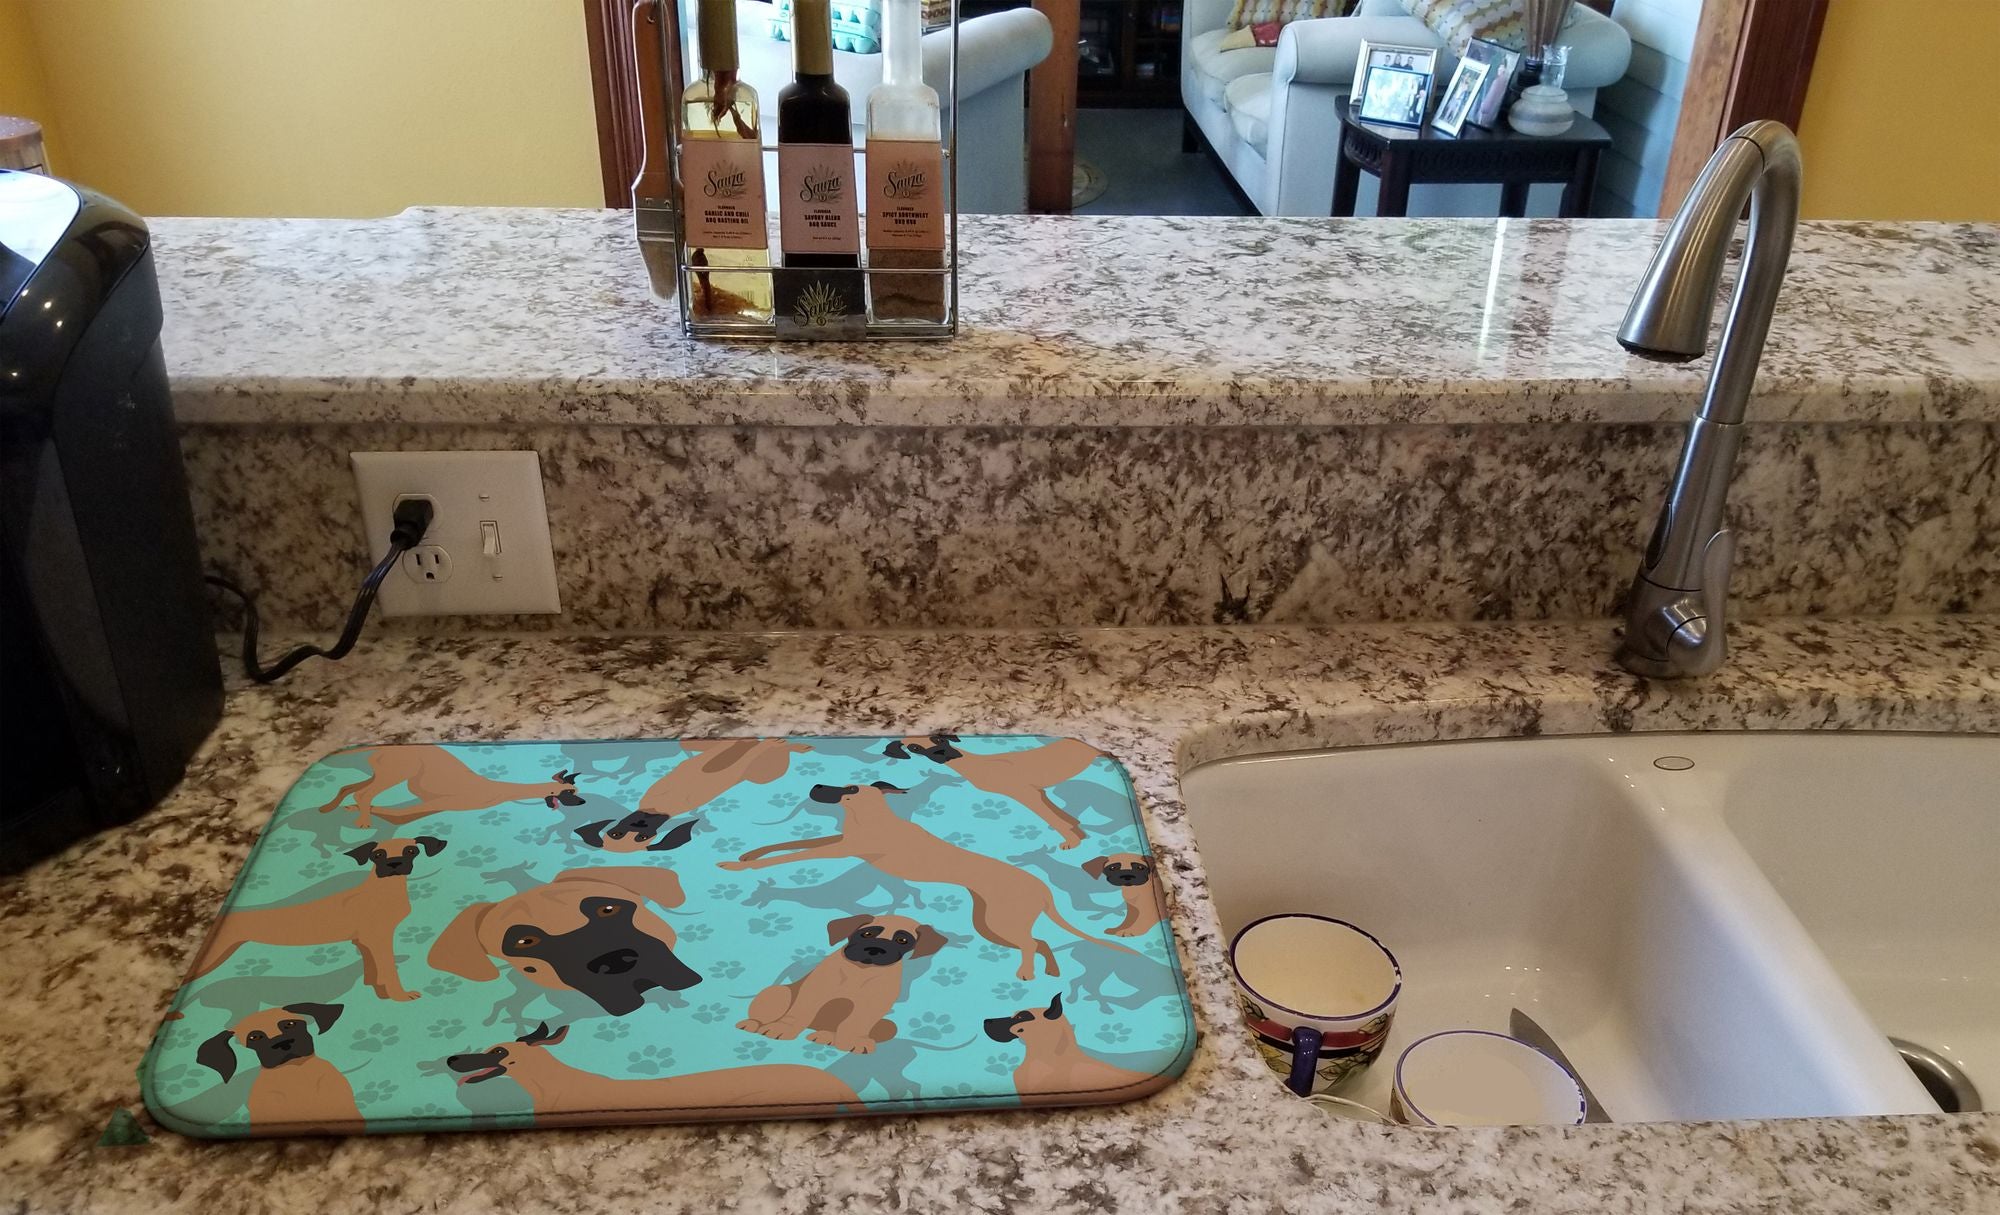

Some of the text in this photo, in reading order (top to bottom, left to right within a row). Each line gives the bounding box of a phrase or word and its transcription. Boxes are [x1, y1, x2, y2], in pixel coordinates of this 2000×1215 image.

[703, 170, 746, 198] Sauza
[800, 175, 842, 202] Sauza
[883, 170, 925, 198] Sauza
[793, 294, 843, 327] Sauza
